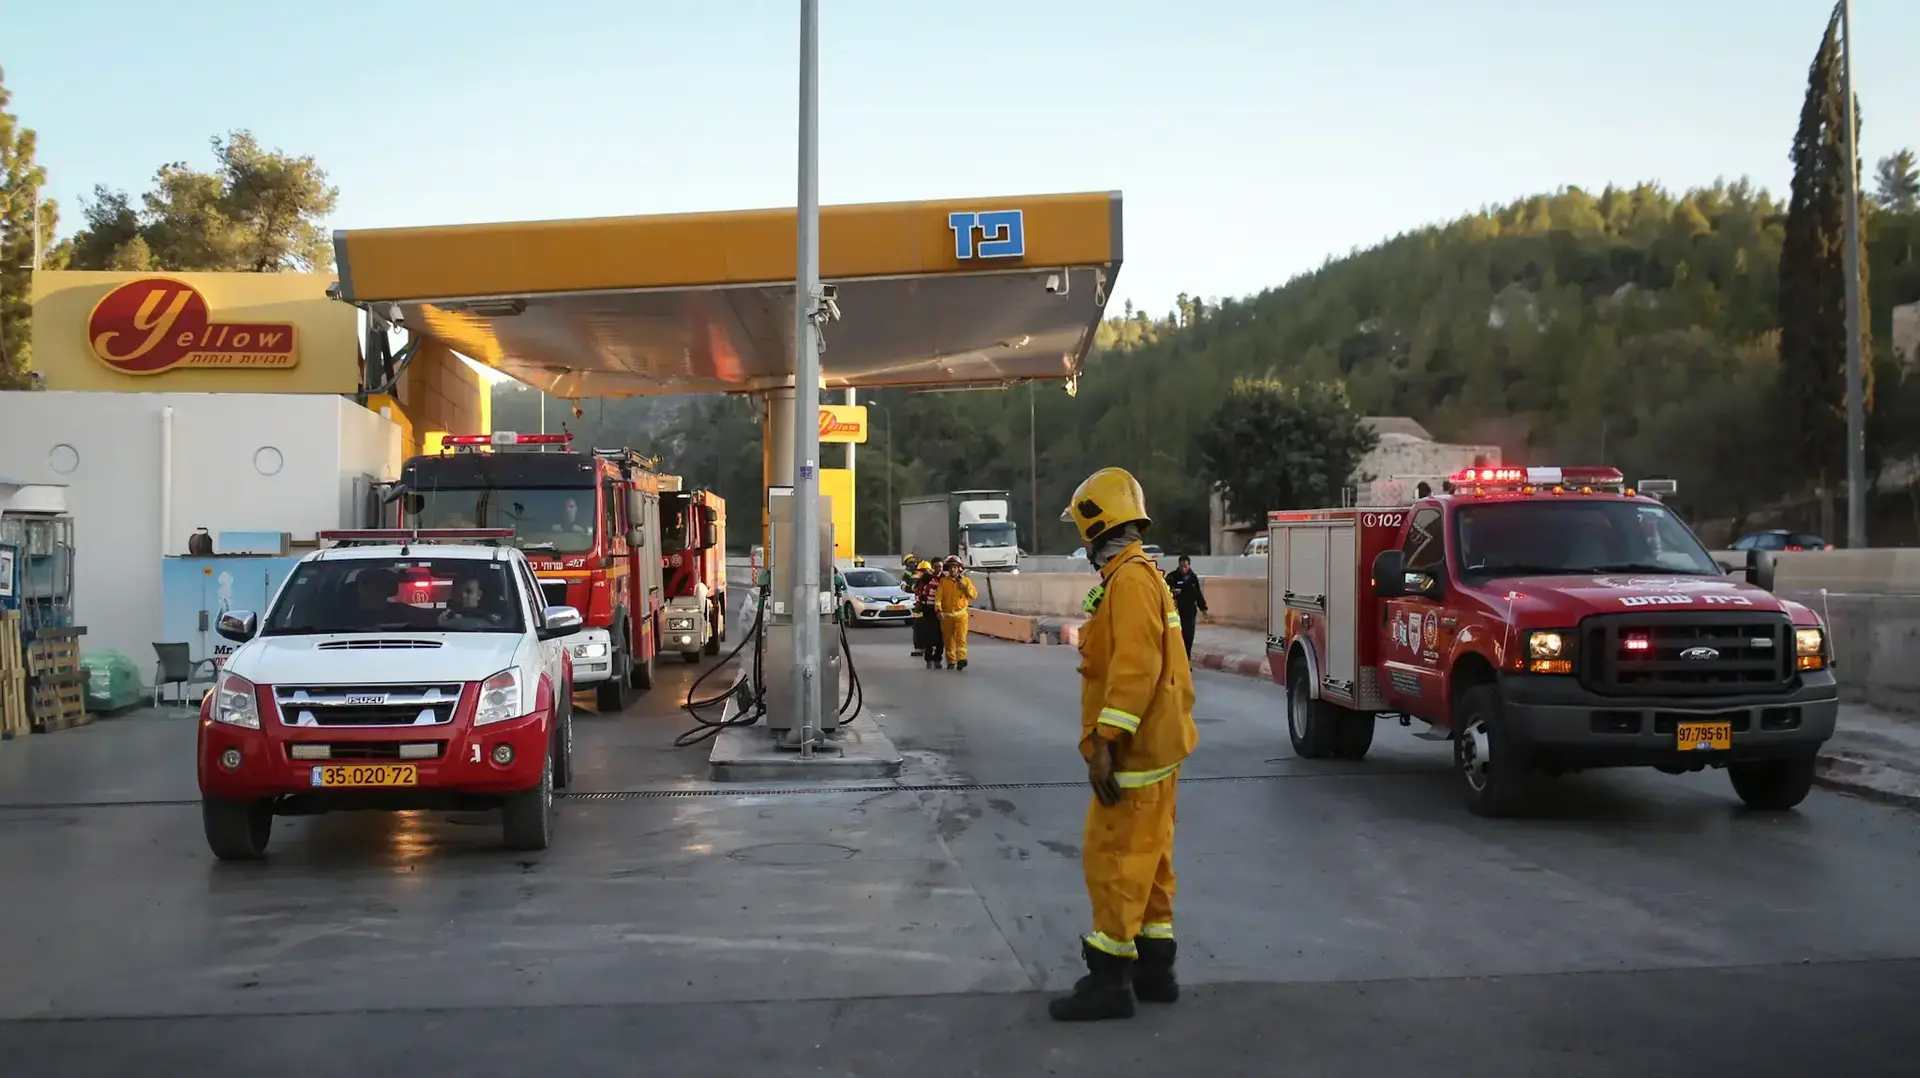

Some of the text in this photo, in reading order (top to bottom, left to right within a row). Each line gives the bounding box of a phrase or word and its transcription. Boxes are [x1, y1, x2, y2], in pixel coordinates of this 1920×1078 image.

[949, 210, 1025, 258] פז
[190, 354, 288, 364] חנויות נוחות
[1377, 513, 1402, 527] 102
[1618, 594, 1753, 607] בית שמש
[348, 696, 384, 704] ISUZU
